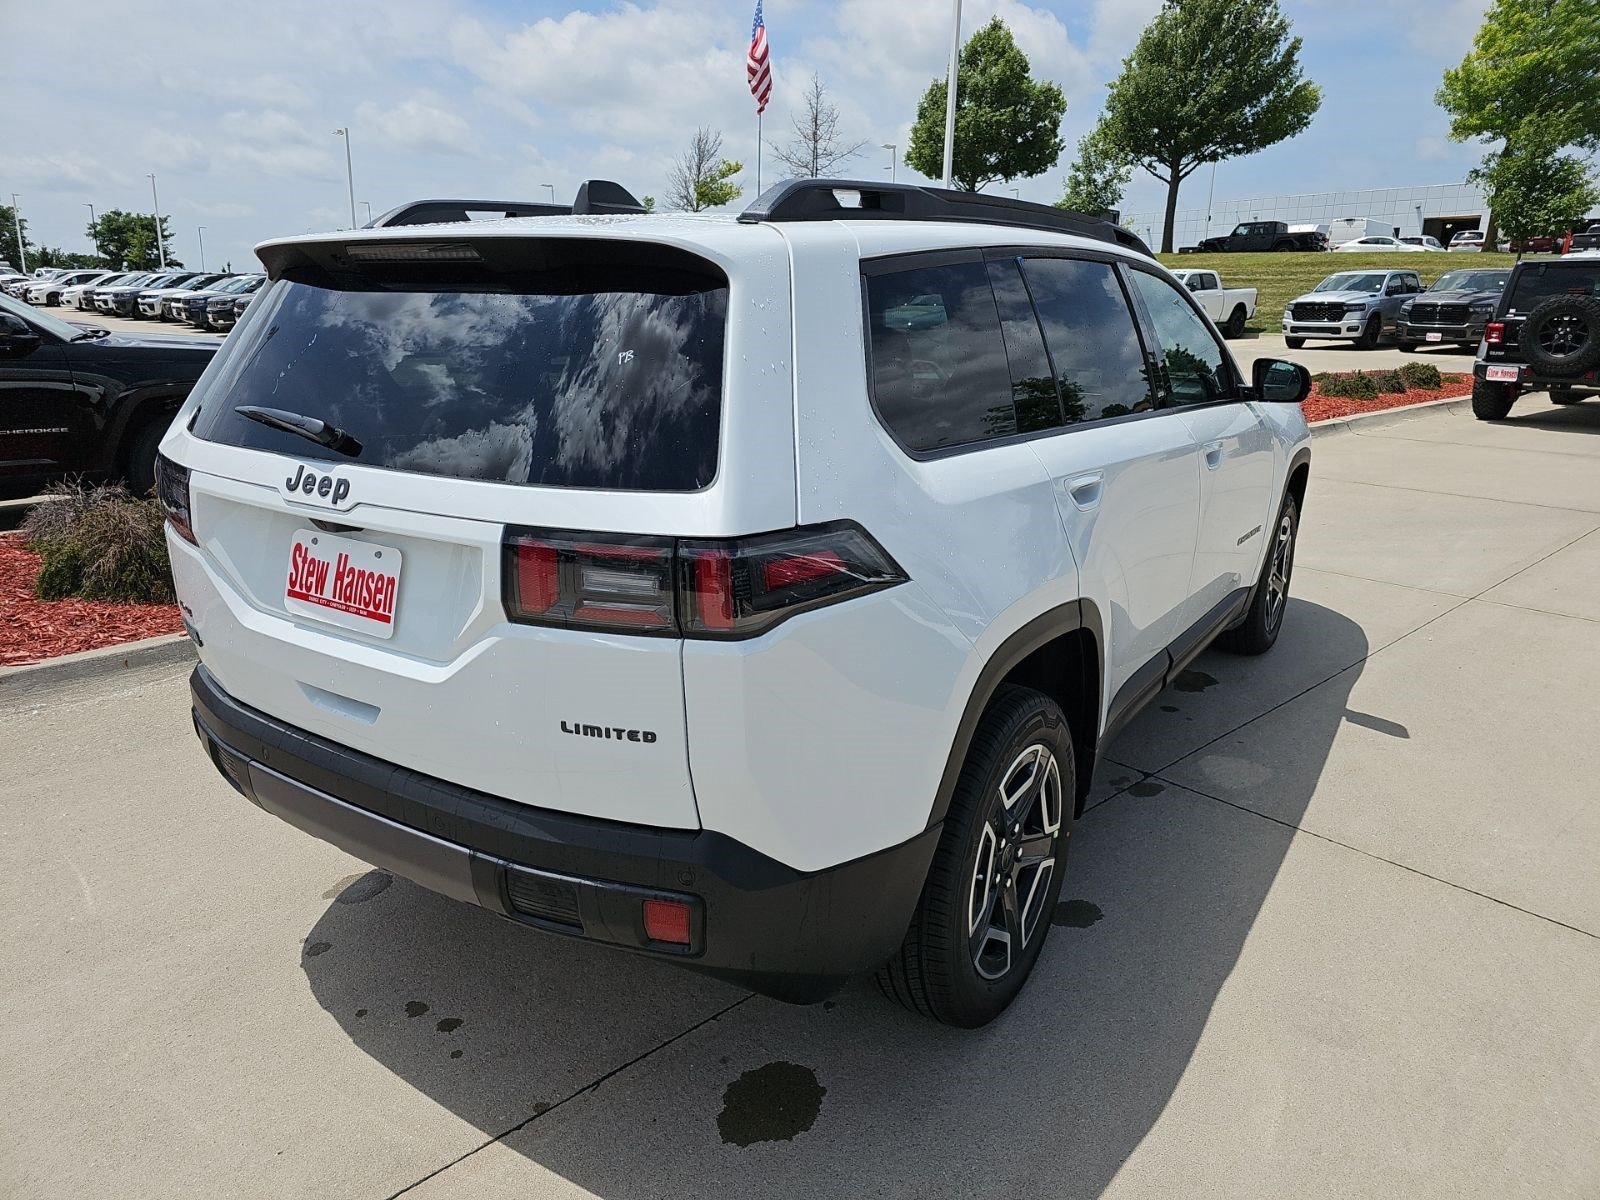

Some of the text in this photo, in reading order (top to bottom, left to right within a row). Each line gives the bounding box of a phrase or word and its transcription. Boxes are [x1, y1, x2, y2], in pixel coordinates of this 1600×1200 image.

[286, 464, 351, 505] Jeep
[288, 542, 396, 614] Stew Hansen
[560, 720, 657, 744] LIMITED
